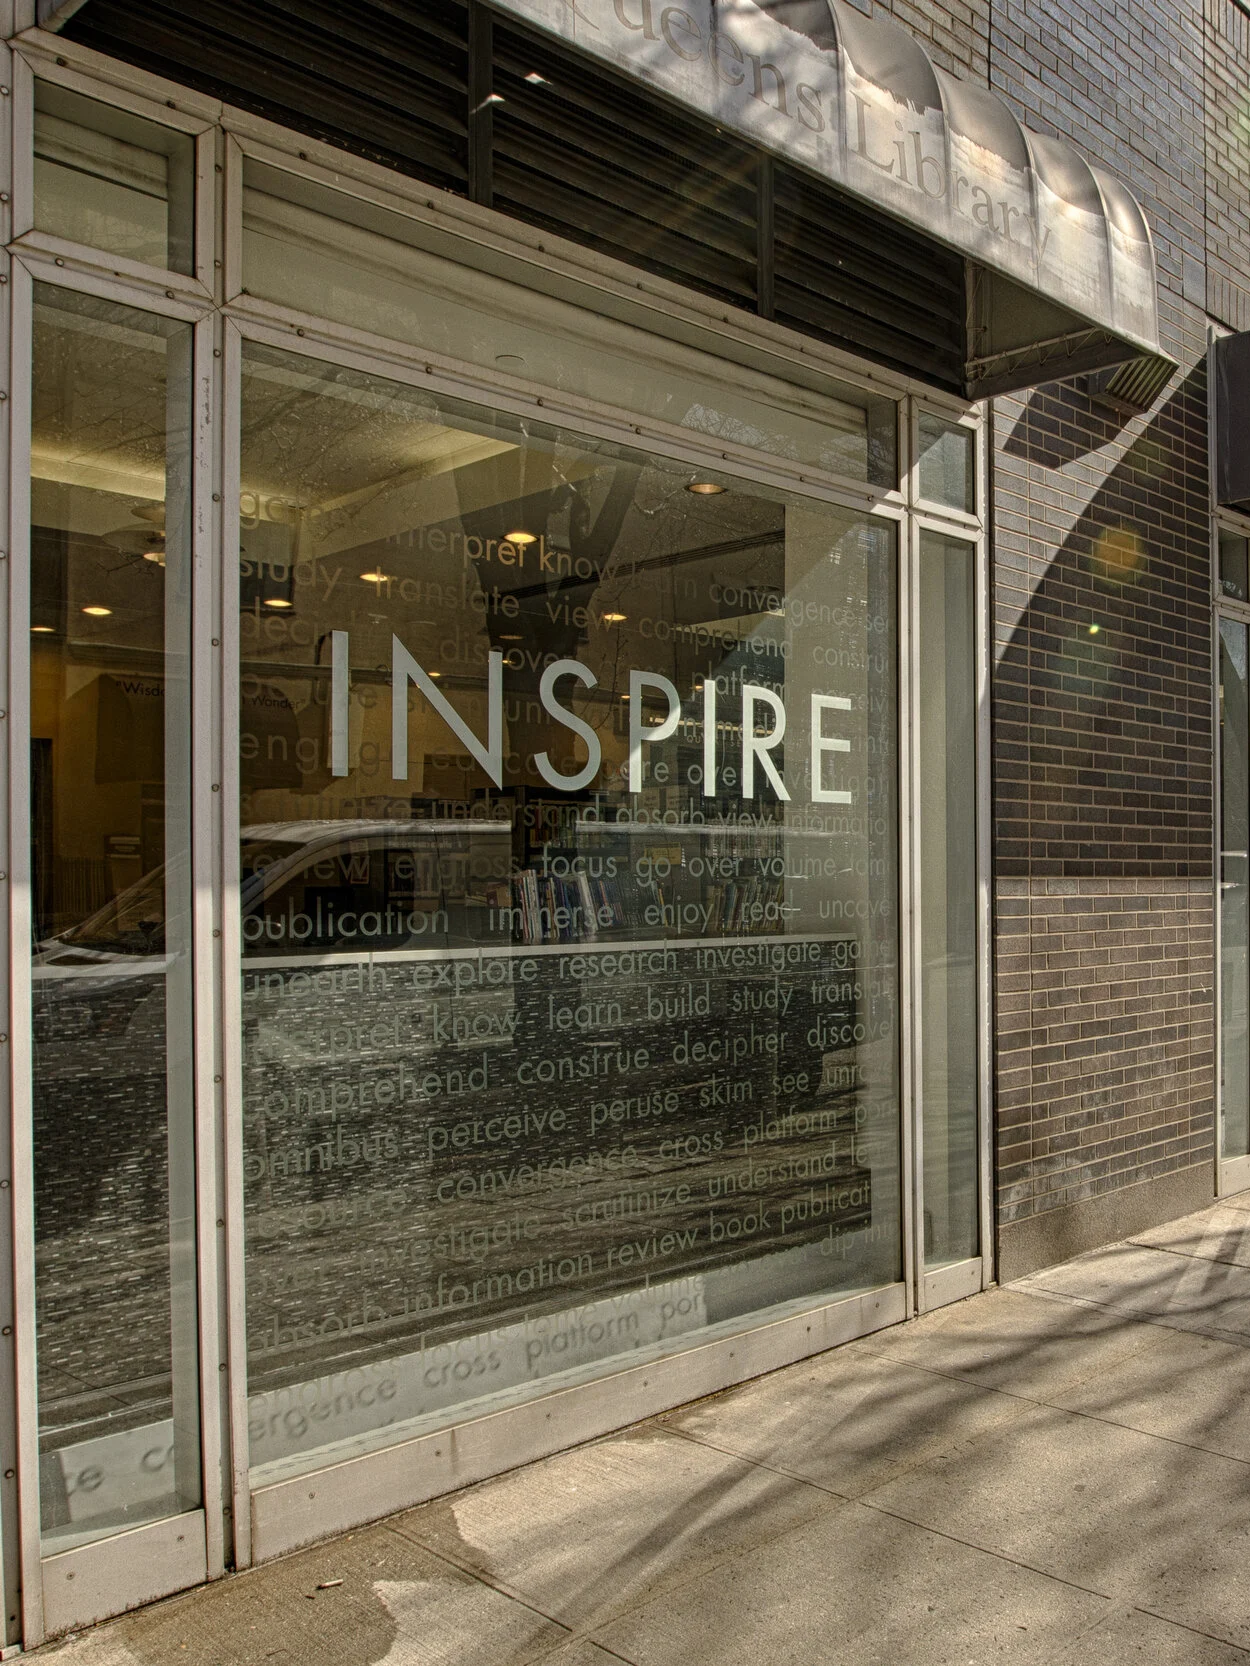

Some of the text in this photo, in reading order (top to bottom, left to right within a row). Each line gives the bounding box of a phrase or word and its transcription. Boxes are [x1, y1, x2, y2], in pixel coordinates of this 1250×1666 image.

[564, 0, 1052, 270] ueens Library
[540, 534, 618, 580] know
[376, 566, 520, 618] translate
[546, 600, 615, 633] view
[639, 617, 793, 659] comprehend
[331, 629, 852, 804] INSPIRE
[616, 793, 705, 825] absorb
[543, 841, 618, 878] focus
[635, 855, 672, 888] go
[688, 854, 744, 879] over
[758, 845, 837, 879] volume
[240, 897, 450, 953] publication
[644, 896, 714, 934] enjoy
[740, 888, 793, 922] read
[412, 947, 539, 998] explore
[559, 937, 678, 979] research
[696, 938, 821, 972] investigate
[433, 1004, 522, 1042] know
[549, 994, 622, 1030] learn
[648, 980, 711, 1020] build
[732, 976, 793, 1014] study
[517, 1047, 650, 1085] construe
[672, 1023, 789, 1069] decipher
[244, 1123, 399, 1182] omnibus
[428, 1104, 567, 1162] perceive
[591, 1092, 680, 1135] peruse
[699, 1072, 753, 1108] skim
[772, 1071, 810, 1097] see
[437, 1147, 638, 1204] convergence
[660, 1129, 724, 1161] cross
[744, 1104, 838, 1154] platform
[562, 1182, 692, 1230] scrutinize
[708, 1141, 838, 1198] understand
[404, 1253, 593, 1314] information
[607, 1225, 699, 1270] review
[710, 1200, 772, 1242] book
